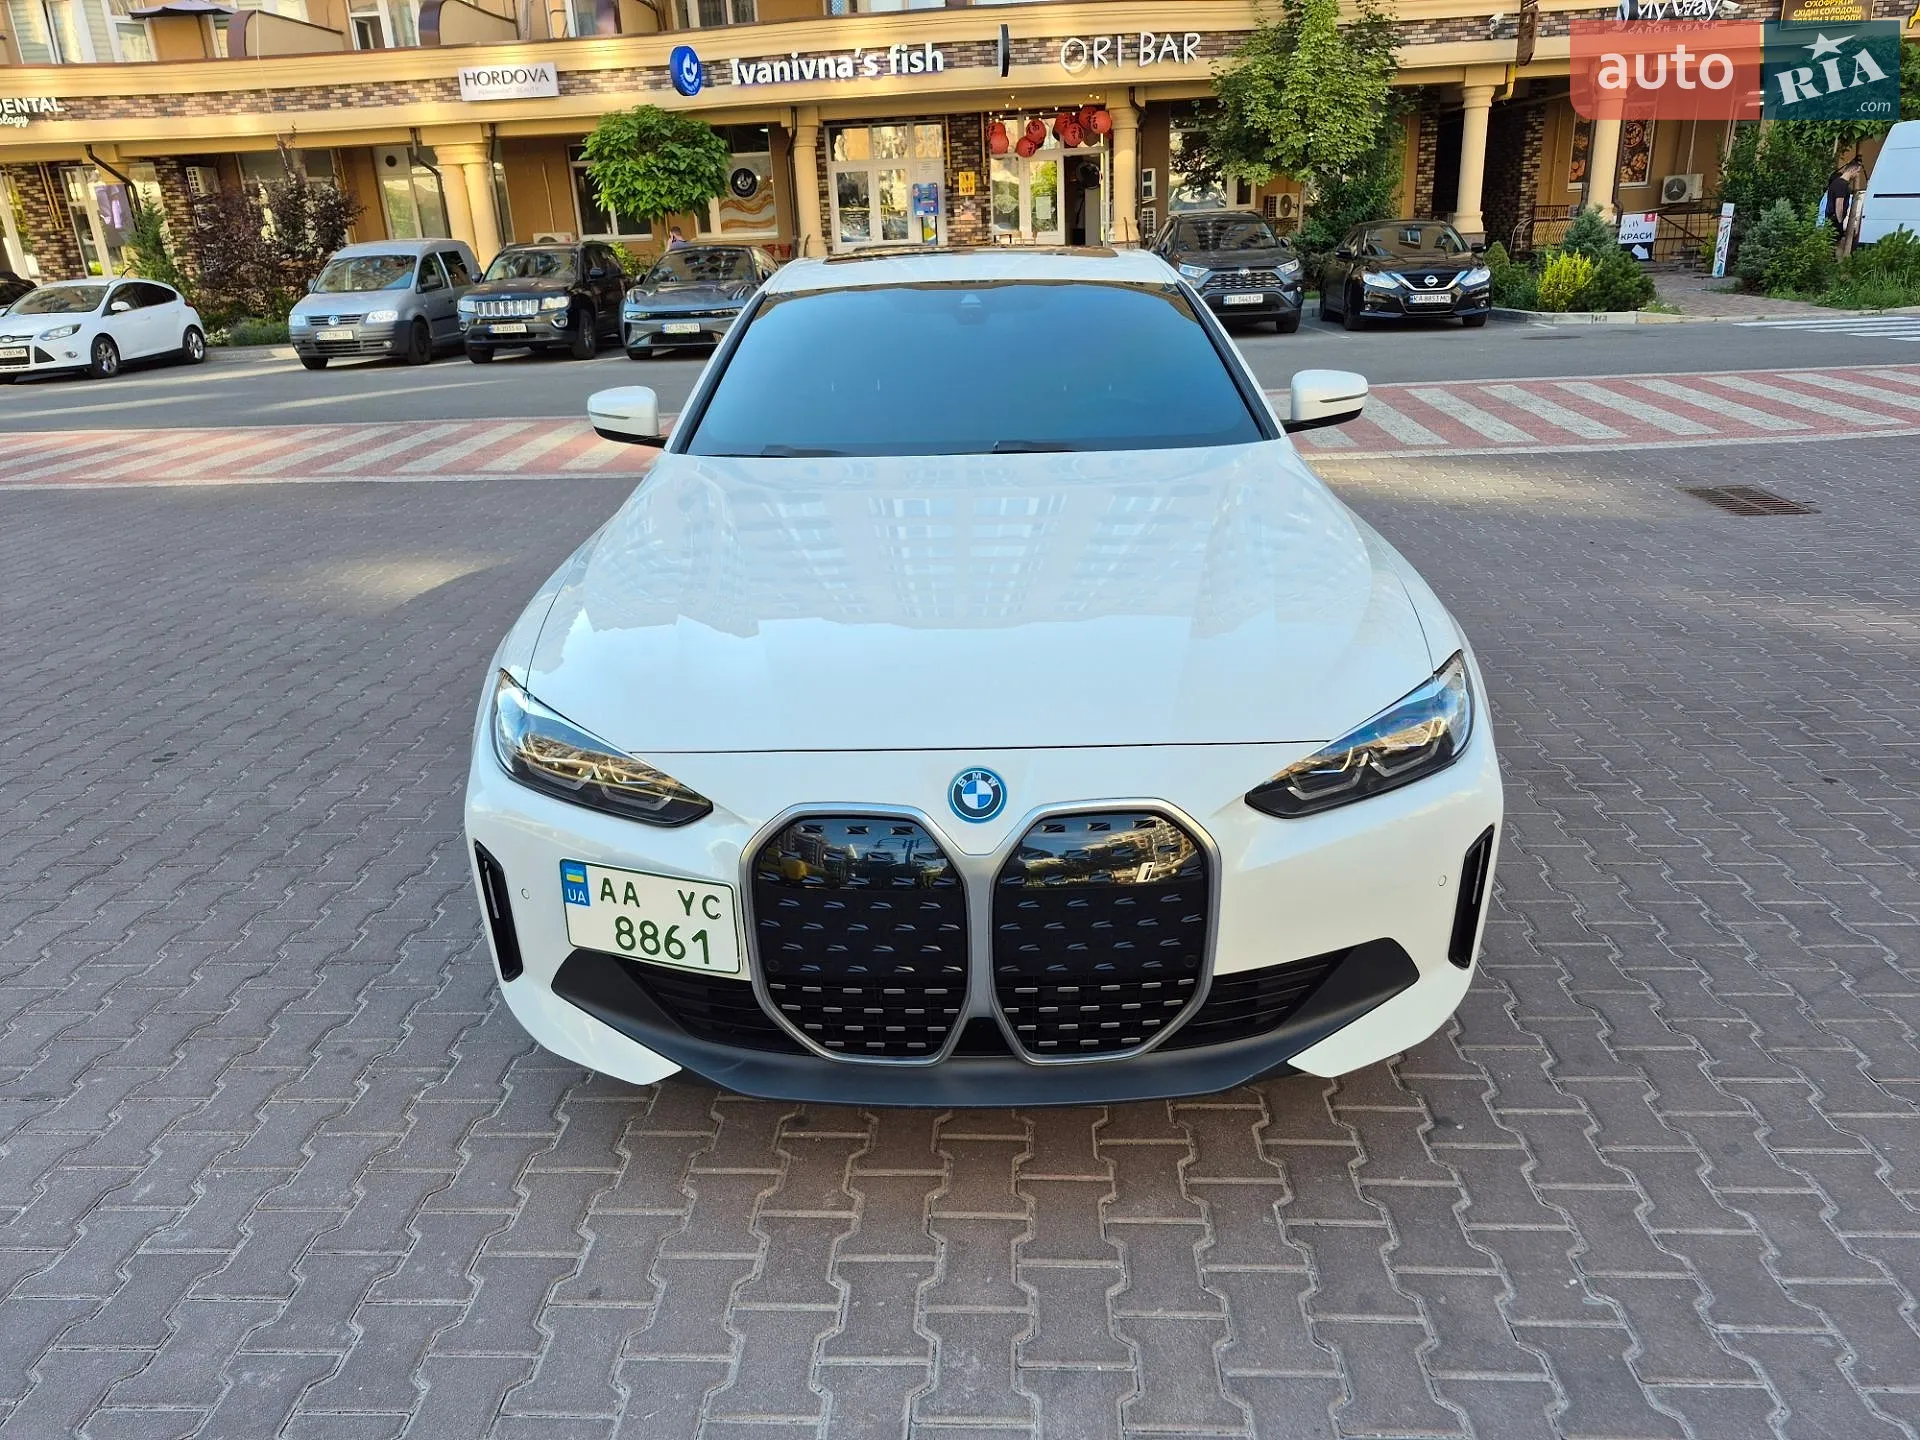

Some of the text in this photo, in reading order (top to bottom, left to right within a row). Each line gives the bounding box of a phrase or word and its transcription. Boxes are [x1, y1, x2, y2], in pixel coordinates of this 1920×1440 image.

[729, 47, 877, 86] Ivanivna's
[887, 42, 945, 75] fish
[1060, 31, 1201, 73] ORI BAR
[463, 67, 550, 87] HORDOVA
[0, 97, 65, 114] ENTAL
[1620, 232, 1652, 241] КРАСИ
[567, 888, 587, 904] UA
[600, 877, 722, 920] AA YC
[614, 915, 710, 965] 8861
